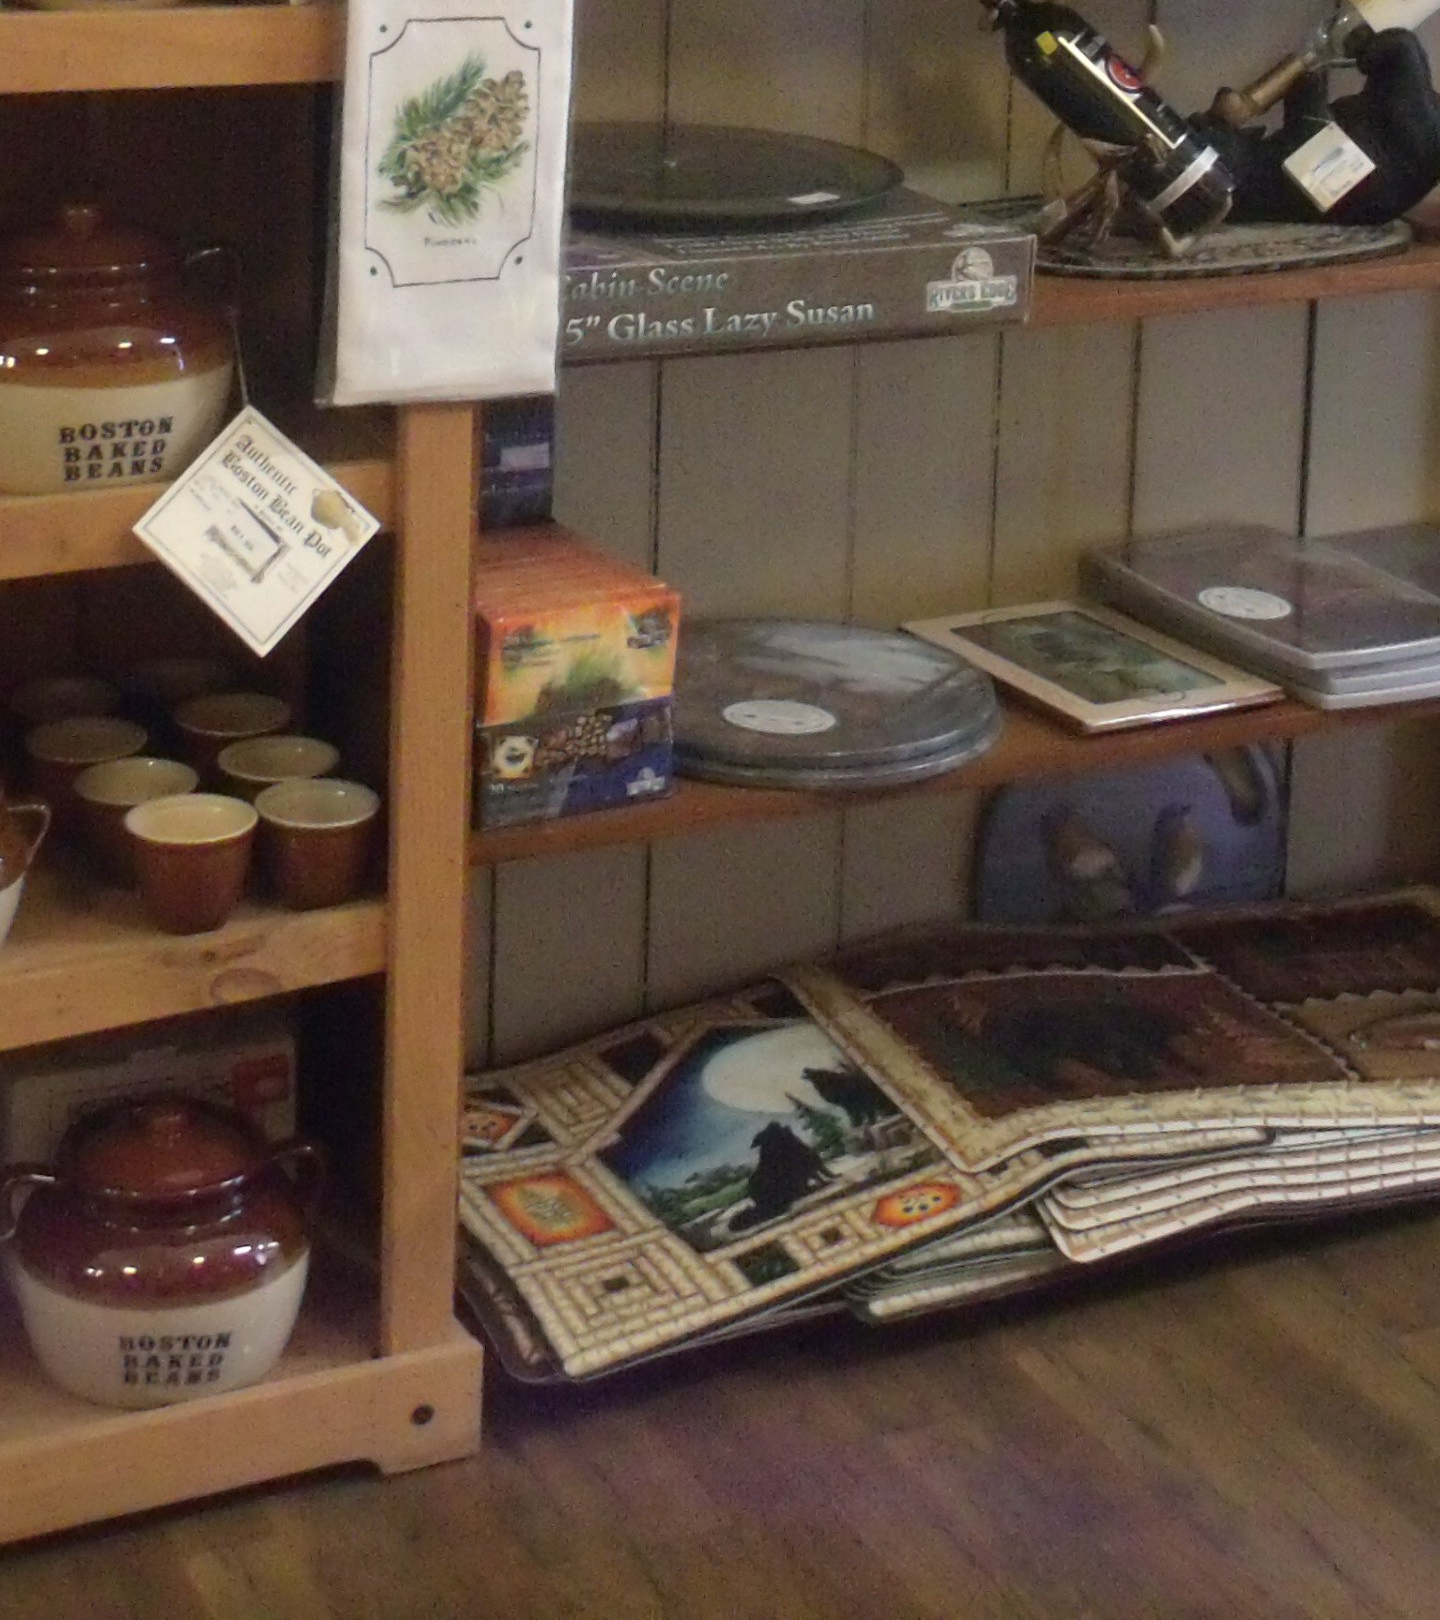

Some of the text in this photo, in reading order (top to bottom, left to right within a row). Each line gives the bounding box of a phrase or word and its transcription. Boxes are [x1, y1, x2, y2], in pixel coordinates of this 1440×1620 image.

[648, 268, 729, 297] Scene
[606, 311, 694, 344] Glass
[704, 305, 779, 341] Lazy
[786, 299, 875, 329] Susan
[60, 415, 174, 443] BOSTON
[63, 437, 167, 463] BAKED
[64, 456, 163, 482] BEANS
[236, 435, 299, 495] Authentic
[222, 450, 333, 559] Boston Bean Pot
[118, 1331, 233, 1352] BOSTON
[123, 1352, 224, 1370] BAKED
